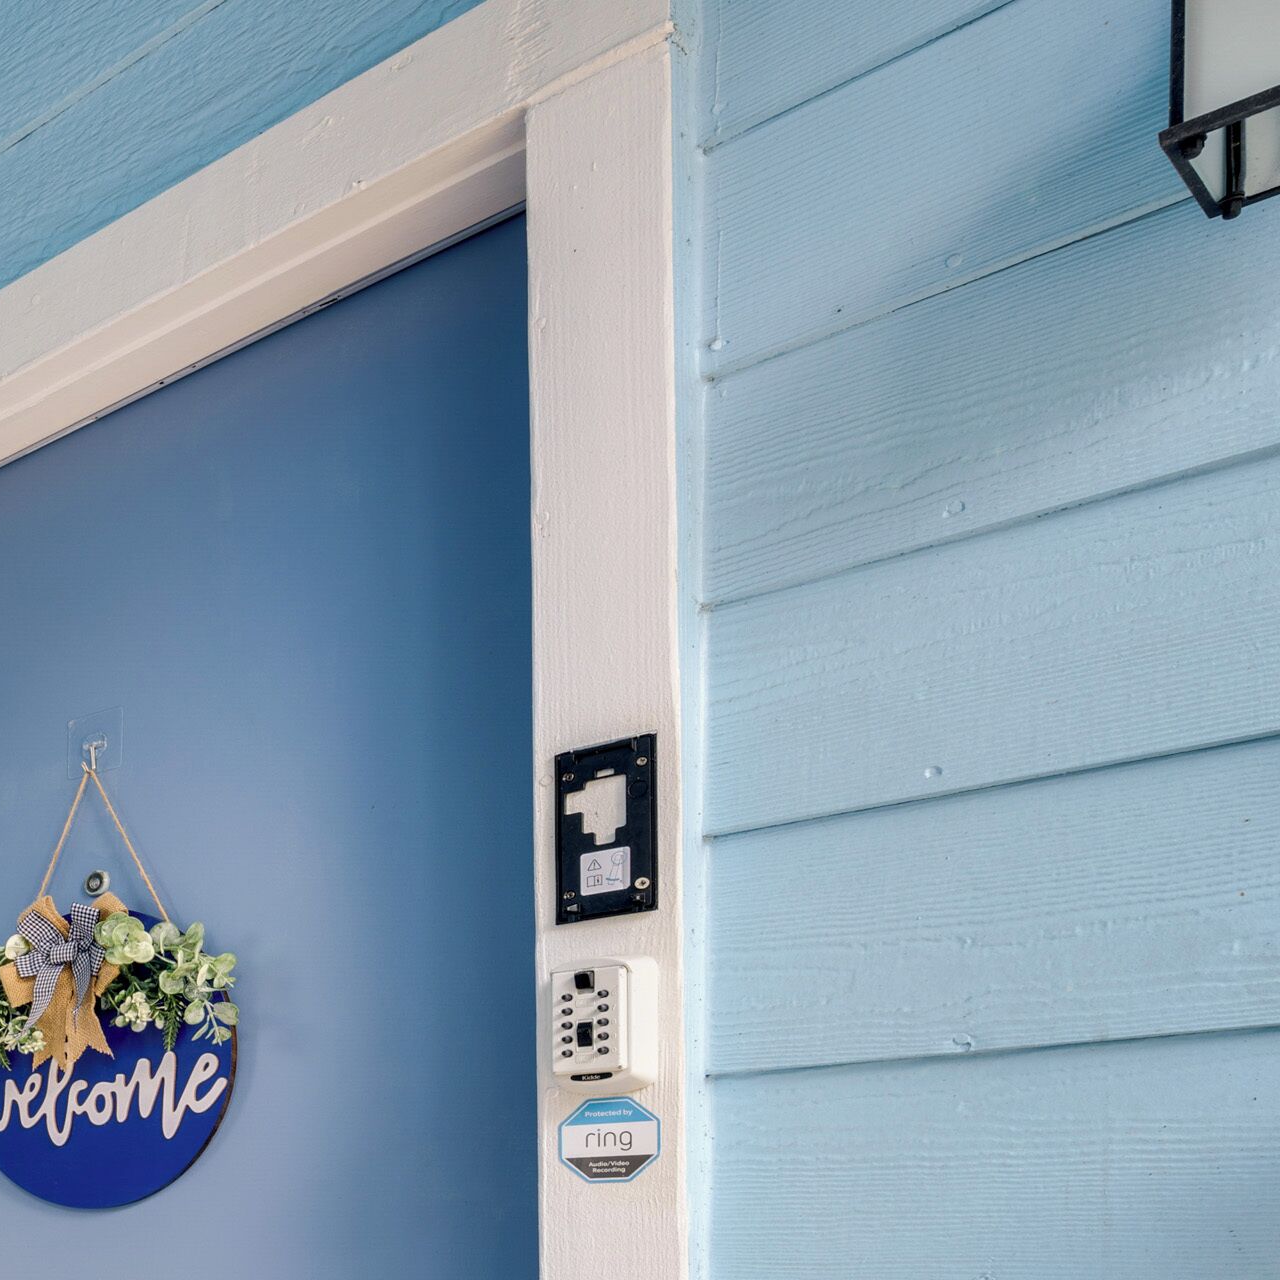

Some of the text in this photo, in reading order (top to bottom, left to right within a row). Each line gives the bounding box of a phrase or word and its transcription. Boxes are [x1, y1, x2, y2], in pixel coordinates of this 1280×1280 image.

[584, 1108, 633, 1117] Protected by
[585, 1128, 633, 1151] ring
